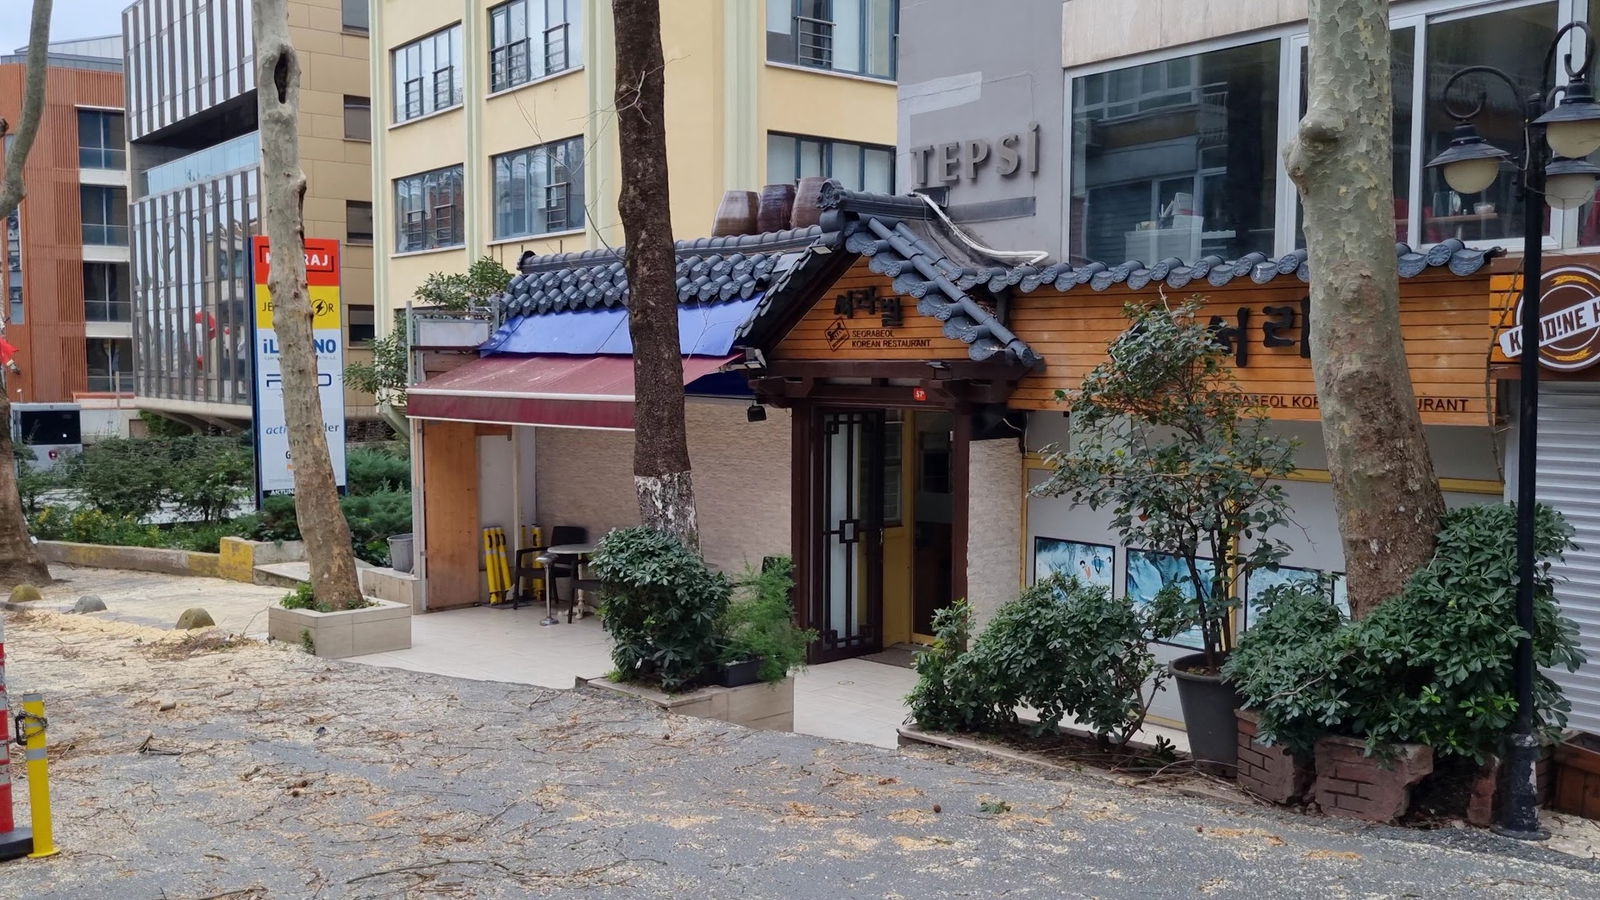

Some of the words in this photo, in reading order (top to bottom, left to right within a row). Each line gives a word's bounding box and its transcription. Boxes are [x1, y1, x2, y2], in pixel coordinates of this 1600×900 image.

[834, 286, 904, 328] 서라벌
[852, 339, 881, 349] KOREAN
[883, 339, 932, 348] RESTAURANT
